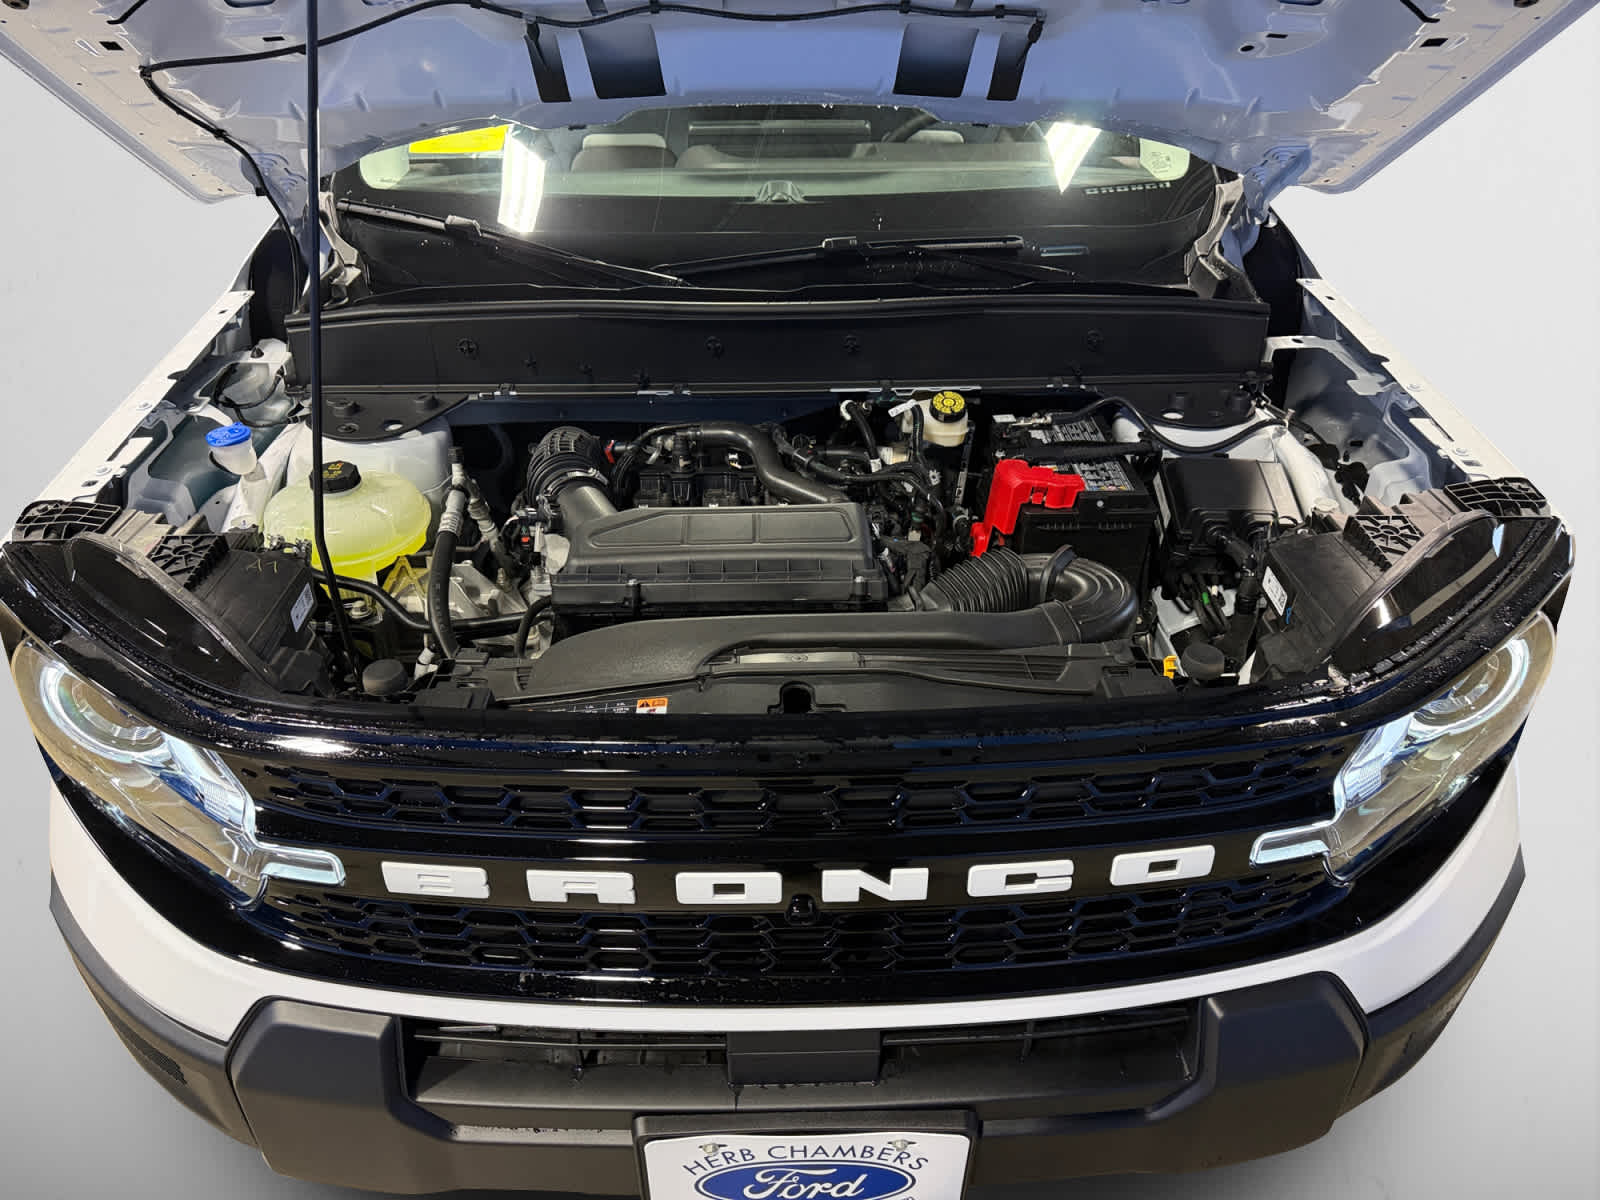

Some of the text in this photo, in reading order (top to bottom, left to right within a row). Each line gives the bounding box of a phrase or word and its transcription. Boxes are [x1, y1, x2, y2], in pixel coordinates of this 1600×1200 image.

[381, 845, 1215, 905] BRONCO
[682, 1145, 928, 1176] HERB CHAMBERS
[743, 1168, 868, 1199] Ford
